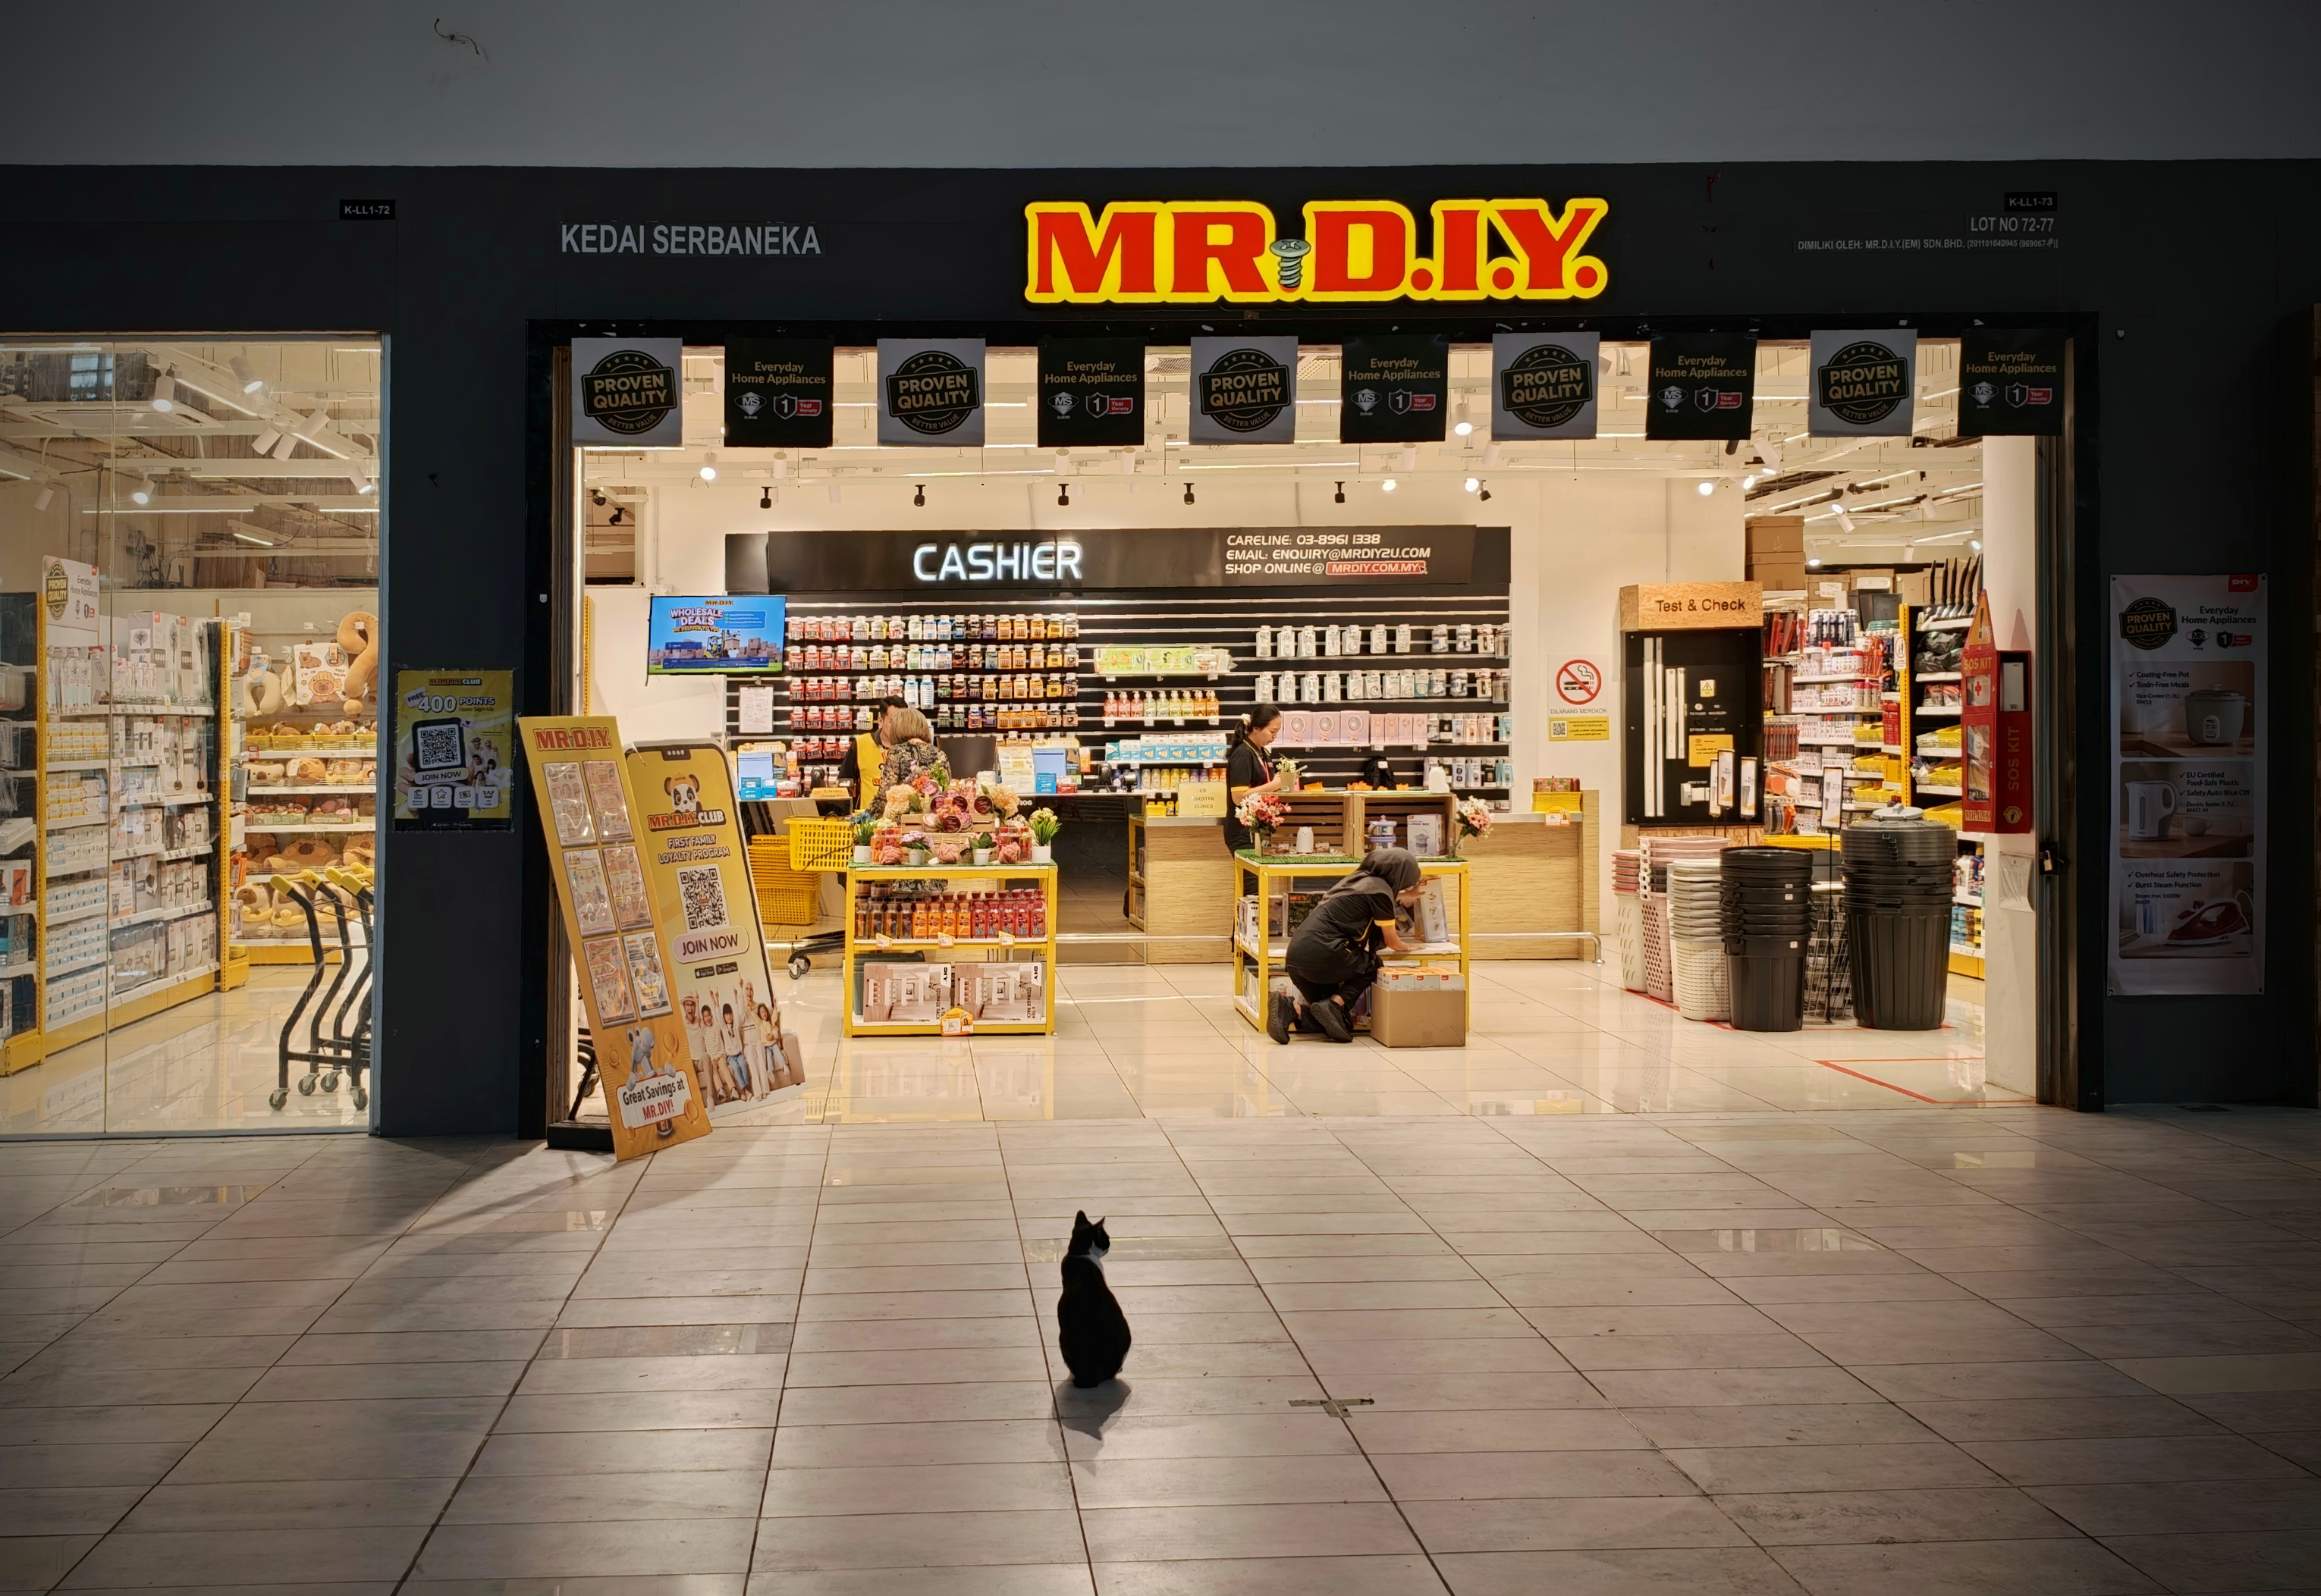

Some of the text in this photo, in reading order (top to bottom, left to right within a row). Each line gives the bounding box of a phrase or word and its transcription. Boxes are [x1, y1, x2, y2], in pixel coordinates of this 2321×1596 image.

[2009, 197, 2053, 206] K-LL1-73
[344, 206, 390, 214] K-LL1-72
[1971, 217, 2054, 232] LOT NO 72-77
[561, 225, 822, 254] KEDAI SERBANEKA
[1798, 240, 1833, 250] DIMILIKI
[1678, 356, 1726, 367] Everyday
[1988, 352, 2036, 362] Everyday
[755, 362, 804, 372] Everyday
[1067, 361, 1115, 372] Everyday
[1371, 358, 1419, 369] Everyday
[1967, 364, 2056, 375] Home Appliances
[733, 374, 826, 385] Home Appliances
[1045, 373, 1137, 385] Home Appliances
[1349, 370, 1440, 382] Home Appliances
[1513, 368, 1581, 386] PROVEN
[1656, 368, 1746, 379] Home Appliances
[1830, 365, 1897, 384] PROVEN
[594, 374, 664, 393] PROVEN
[899, 374, 967, 393] PROVEN
[1211, 372, 1279, 391] PROVEN
[1512, 384, 1584, 403] QUALITY
[1665, 390, 1682, 399] MS
[1829, 381, 1899, 399] QUALITY
[1975, 387, 1992, 395] MS
[2013, 388, 2020, 402] 1
[594, 390, 668, 409] QUALITY
[742, 397, 759, 406] MS
[898, 390, 970, 409] QUALITY
[1056, 397, 1072, 406] MS
[1210, 388, 1281, 407] QUALITY
[1359, 394, 1375, 402] MS
[1397, 394, 1403, 408] 1
[1703, 392, 1709, 406] 1
[781, 398, 788, 413] 1
[1094, 397, 1100, 411] 1
[1227, 534, 1381, 545] CARELINE: 03-8961 1338
[1226, 548, 1430, 560] EMAIL: ENQUIRY@MRDIY2U.COM
[913, 543, 1082, 581] CASHIER
[1225, 563, 1261, 574] SHOP
[1332, 563, 1417, 573] MRDIY.COM.MY
[48, 591, 66, 600] QUALITY
[1656, 599, 1745, 612] Test & Check
[2200, 606, 2239, 614] Everyday
[671, 608, 723, 617] WHOLESALE
[2127, 613, 2170, 623] PROVEN
[680, 617, 714, 625] DEALS
[2209, 616, 2256, 624] Appliances
[2127, 623, 2172, 634] QUALITY
[1964, 657, 1992, 671] SOS KIT
[419, 696, 456, 712] 400
[460, 697, 495, 705] POINTS
[2008, 728, 2019, 790] SOS KIT
[698, 811, 724, 823] CLUB
[668, 835, 716, 848] FIRST FAMILY
[658, 847, 730, 864] LOYALTY PROGRAM
[682, 934, 738, 956] JOIN NOW
[623, 1079, 685, 1105] Great Savings at
[643, 1099, 675, 1120] MR.DIY!
